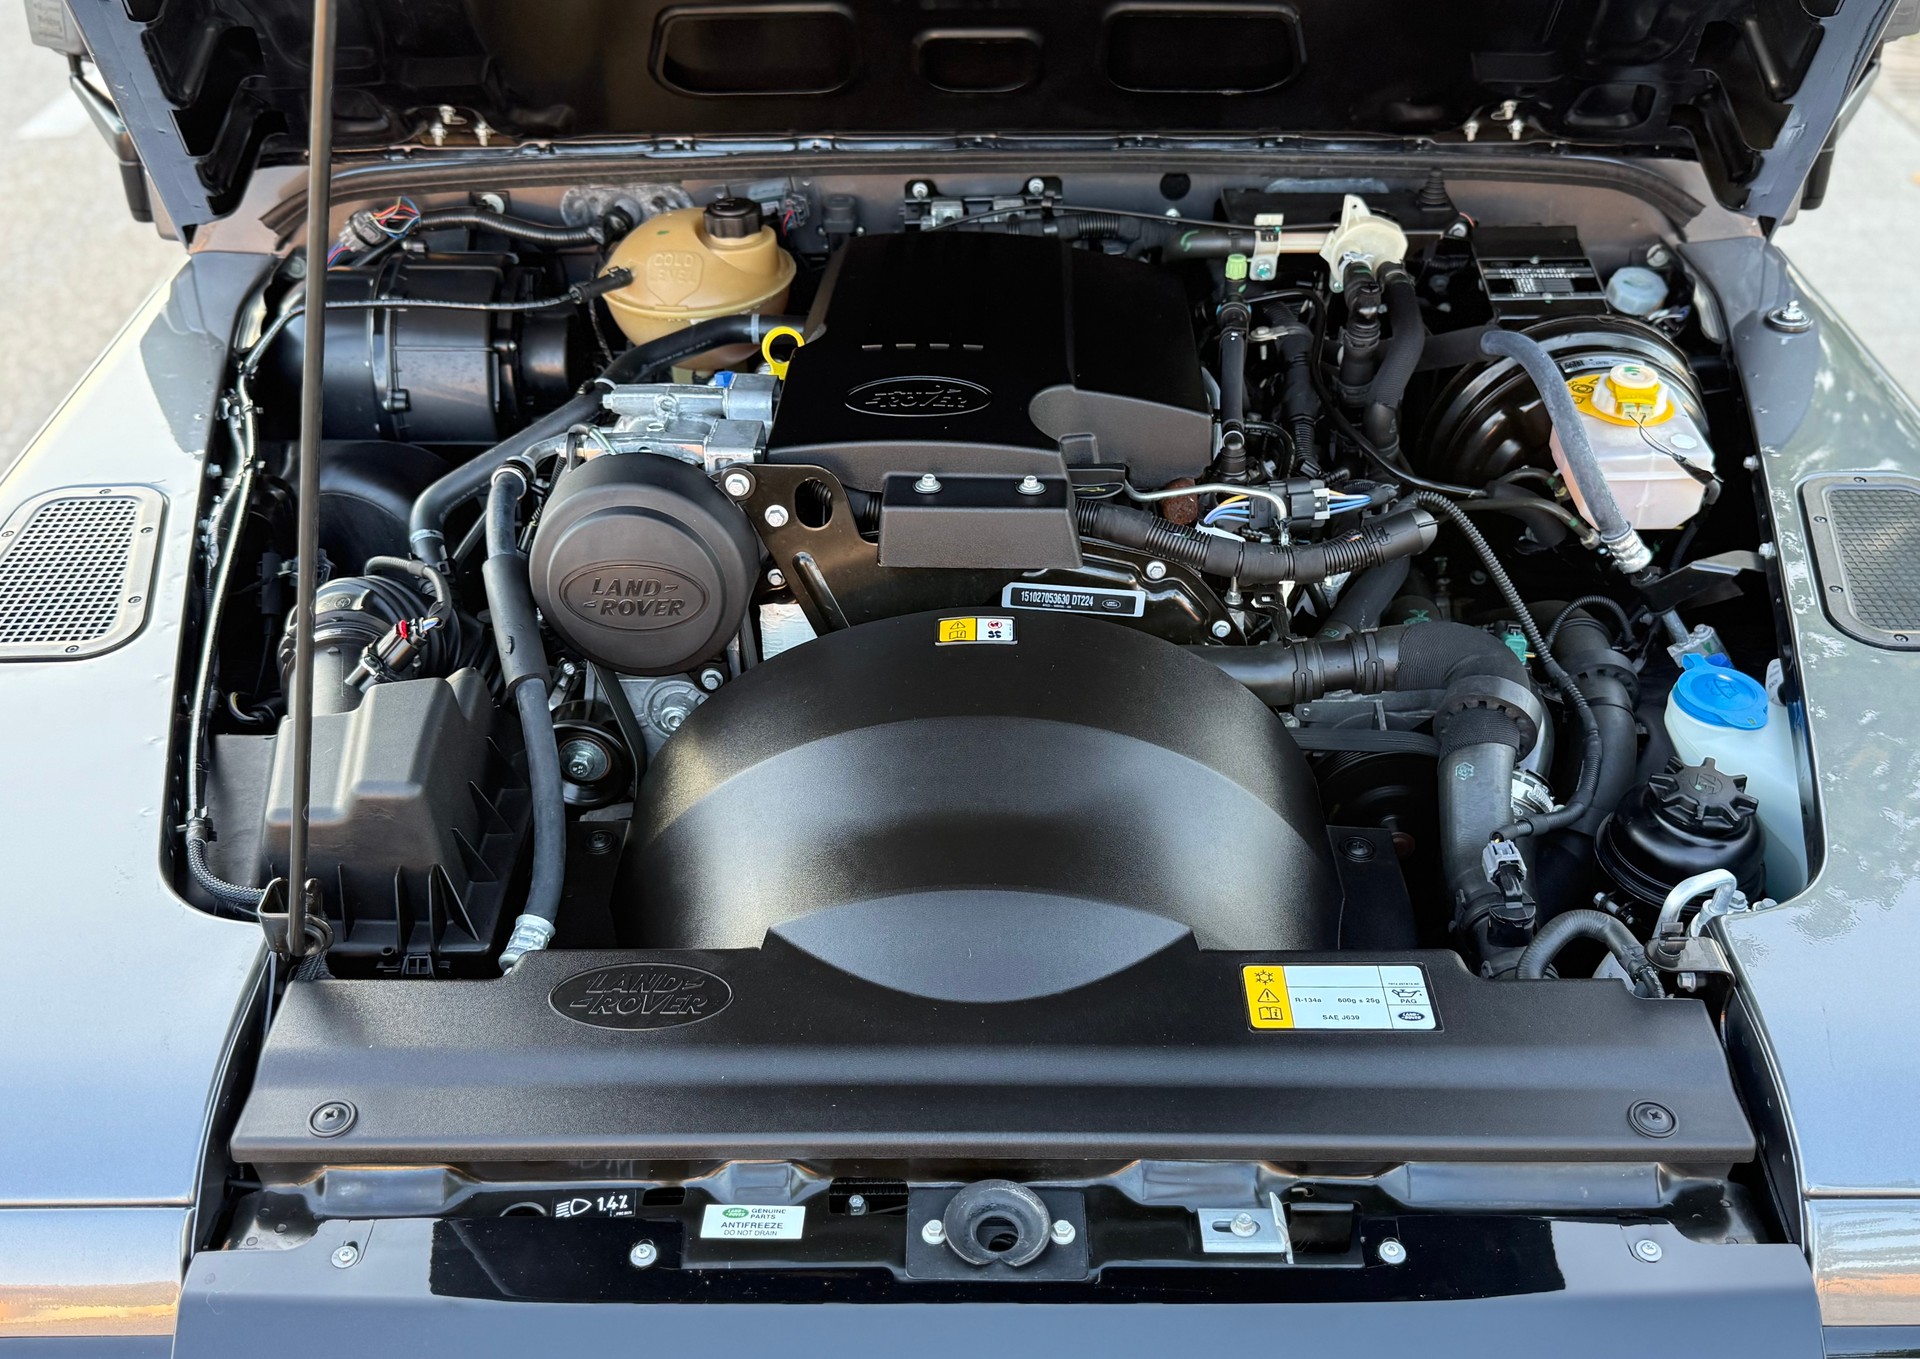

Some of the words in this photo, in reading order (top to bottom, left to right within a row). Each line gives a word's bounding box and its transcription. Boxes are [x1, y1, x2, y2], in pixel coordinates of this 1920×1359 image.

[653, 253, 695, 268] COLD
[591, 577, 662, 597] LAND
[600, 598, 686, 617] ROVER
[1071, 594, 1094, 607] DT224
[586, 974, 683, 994] LAND
[588, 994, 708, 1015] ROVER
[720, 1221, 783, 1229] ANTIFREEZE
